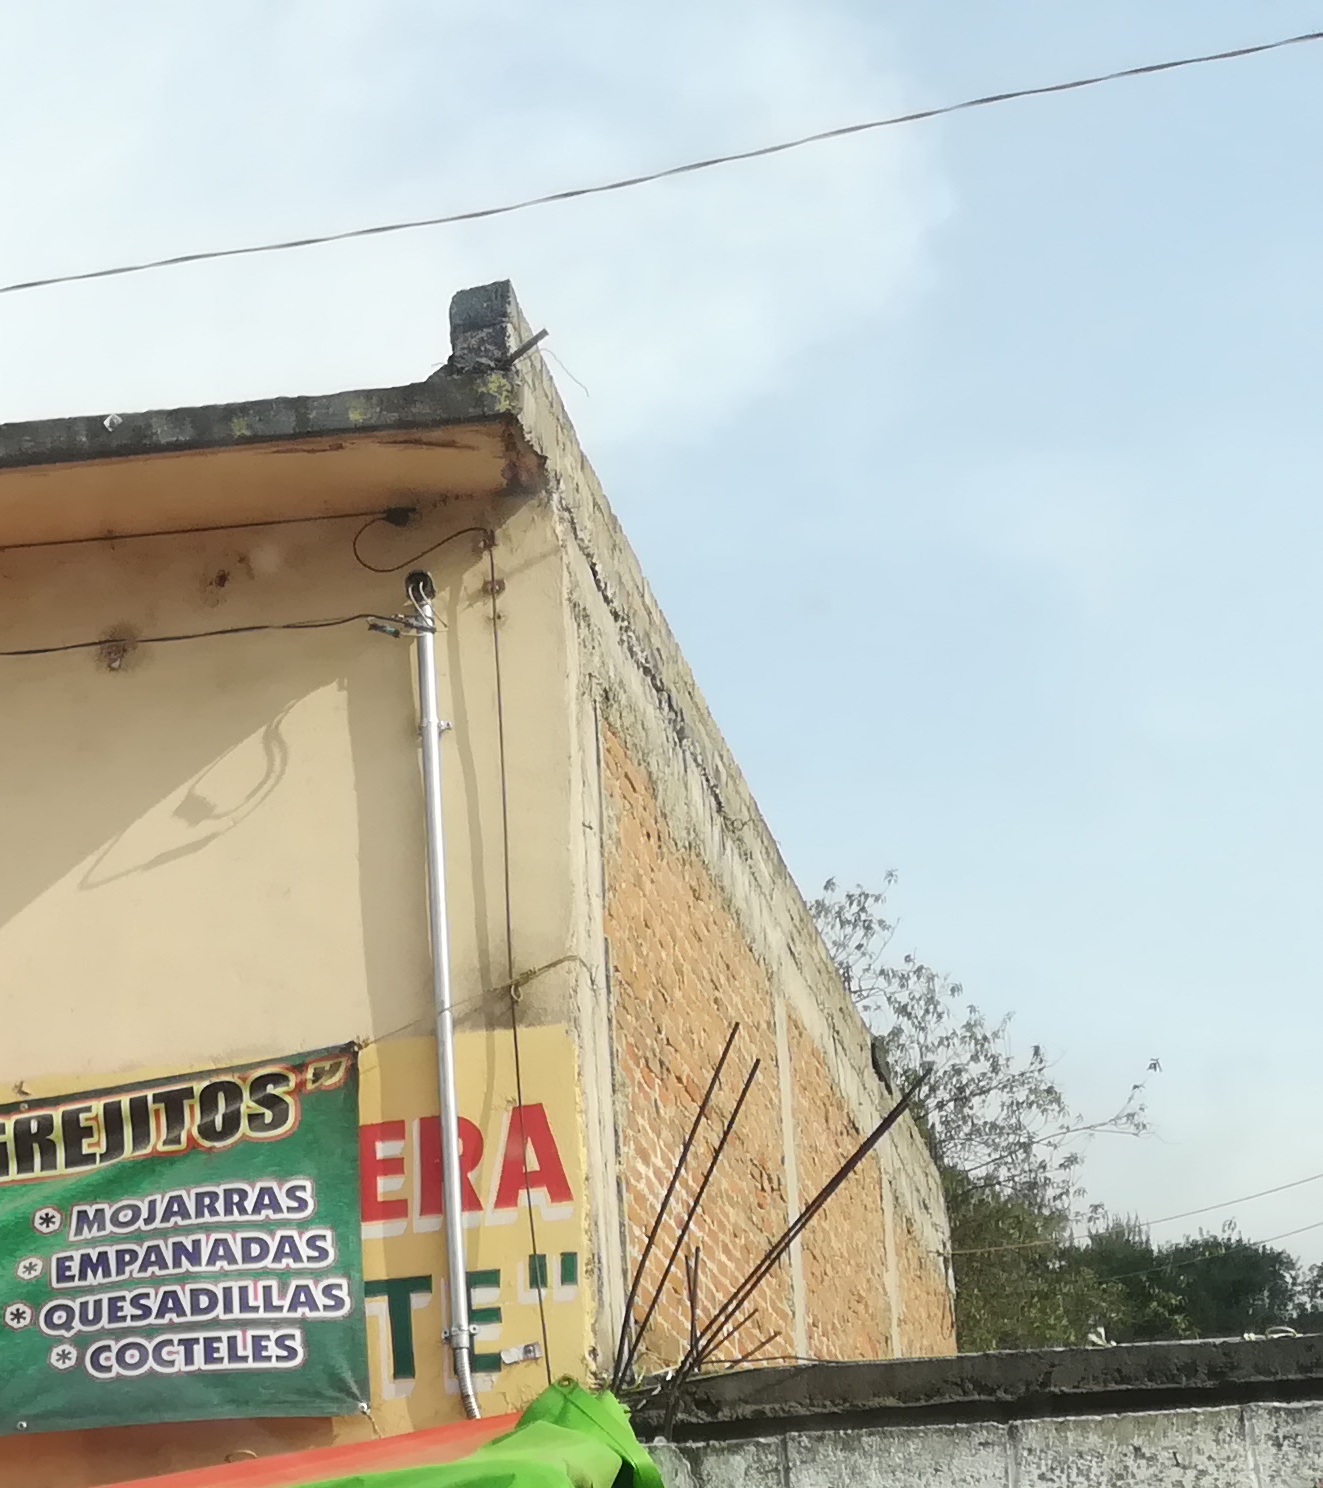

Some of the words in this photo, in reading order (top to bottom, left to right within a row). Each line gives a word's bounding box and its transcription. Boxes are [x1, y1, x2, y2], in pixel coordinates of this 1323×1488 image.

[71, 1181, 313, 1240] MOJARRAS
[53, 1231, 334, 1287] EMPANADAS
[41, 1279, 349, 1336] QUESADILLAS
[87, 1331, 302, 1377] COCTELES
